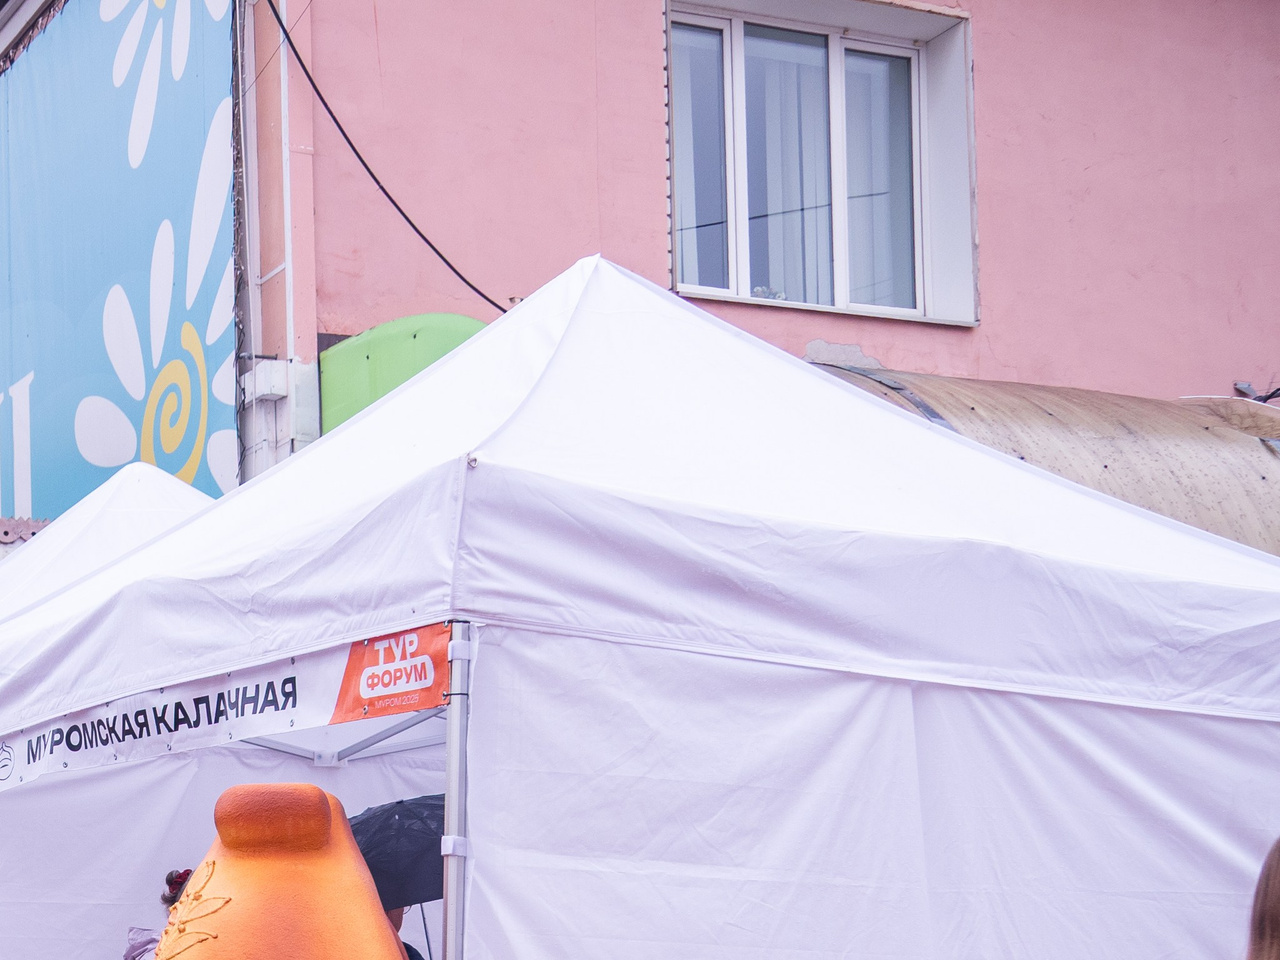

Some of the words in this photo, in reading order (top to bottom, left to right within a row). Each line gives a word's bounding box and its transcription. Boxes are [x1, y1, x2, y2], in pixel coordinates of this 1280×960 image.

[374, 633, 419, 666] ТУР
[366, 661, 428, 691] ФОРУМ
[375, 697, 401, 709] МУРОМ
[402, 694, 420, 705] 2025
[27, 709, 152, 766] МУРОМСКАЯ
[152, 676, 297, 735] КАЛАЧНАЯ
